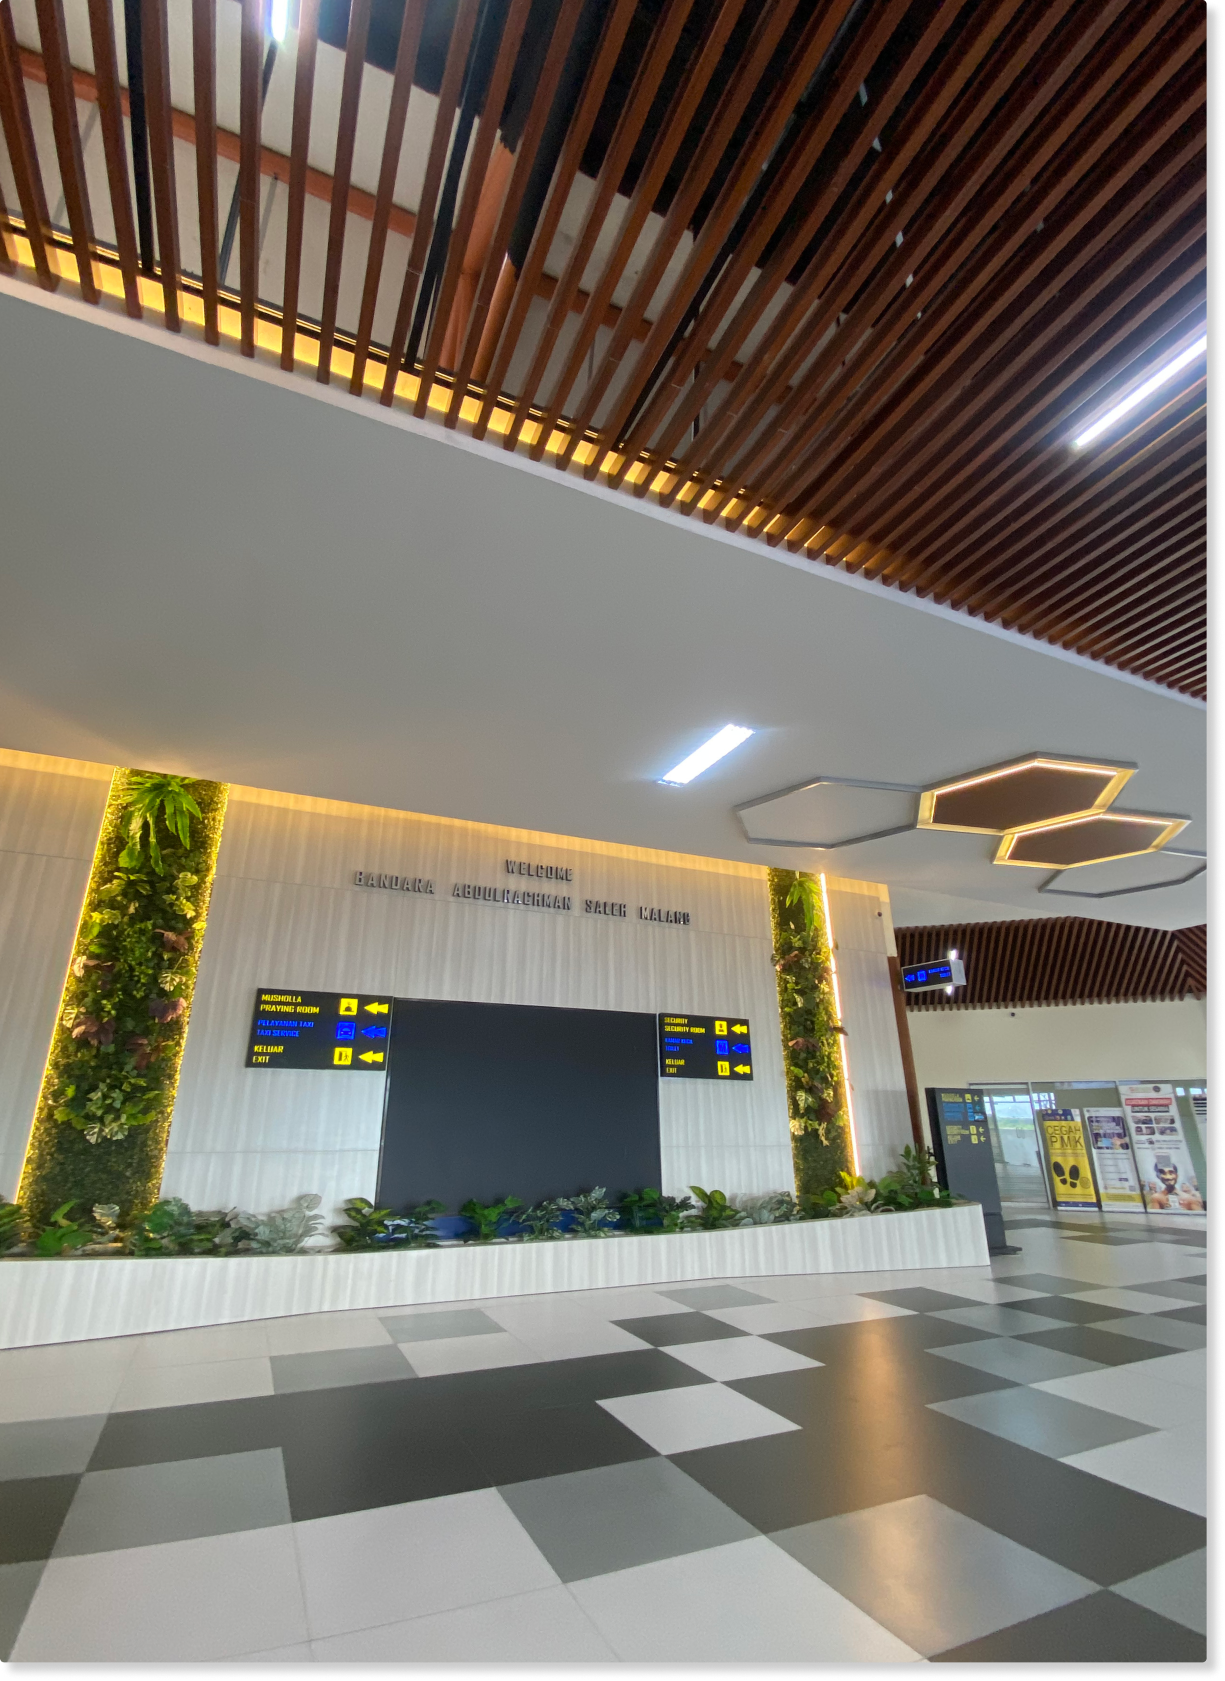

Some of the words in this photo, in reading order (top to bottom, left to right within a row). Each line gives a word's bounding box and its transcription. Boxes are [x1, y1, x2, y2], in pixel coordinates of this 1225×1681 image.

[506, 859, 573, 881] WELCOME
[355, 871, 434, 894] BANDARA
[453, 883, 571, 910] ABDULRACHMAN
[585, 899, 627, 917] SALEH
[640, 906, 690, 925] MALANG
[261, 994, 302, 1003] MUSHOLLA
[260, 1004, 295, 1013] PRAYING
[296, 1005, 319, 1014] ROOM
[257, 1020, 298, 1028] PELAYANAN
[272, 1029, 299, 1037] SERVICE
[664, 1025, 689, 1033] SECURITY
[690, 1026, 705, 1034] ROOM
[254, 1045, 284, 1053] KELUAR
[1046, 1125, 1081, 1136] CEGAH
[1050, 1135, 1084, 1148] PMK
